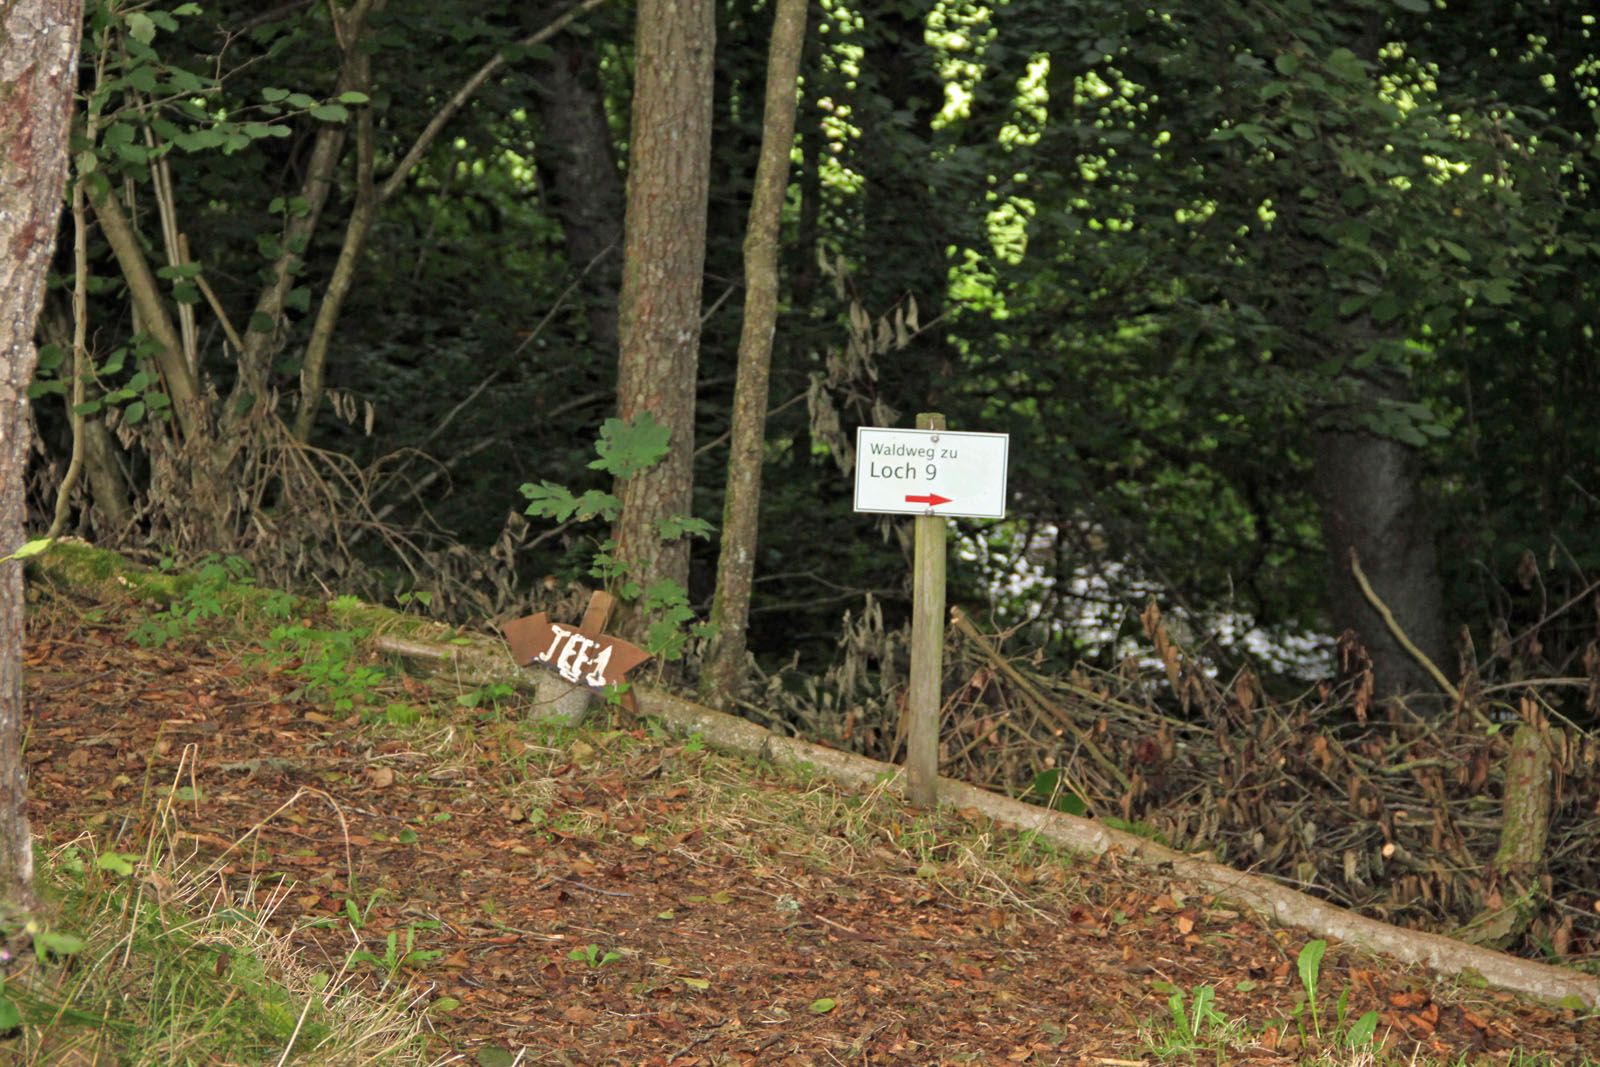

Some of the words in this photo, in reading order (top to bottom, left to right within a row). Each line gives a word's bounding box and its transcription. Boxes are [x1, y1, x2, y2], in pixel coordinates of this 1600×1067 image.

[870, 443, 935, 460] Waldweg
[940, 448, 958, 459] zu
[870, 462, 916, 479] Loch
[925, 463, 937, 480] 9
